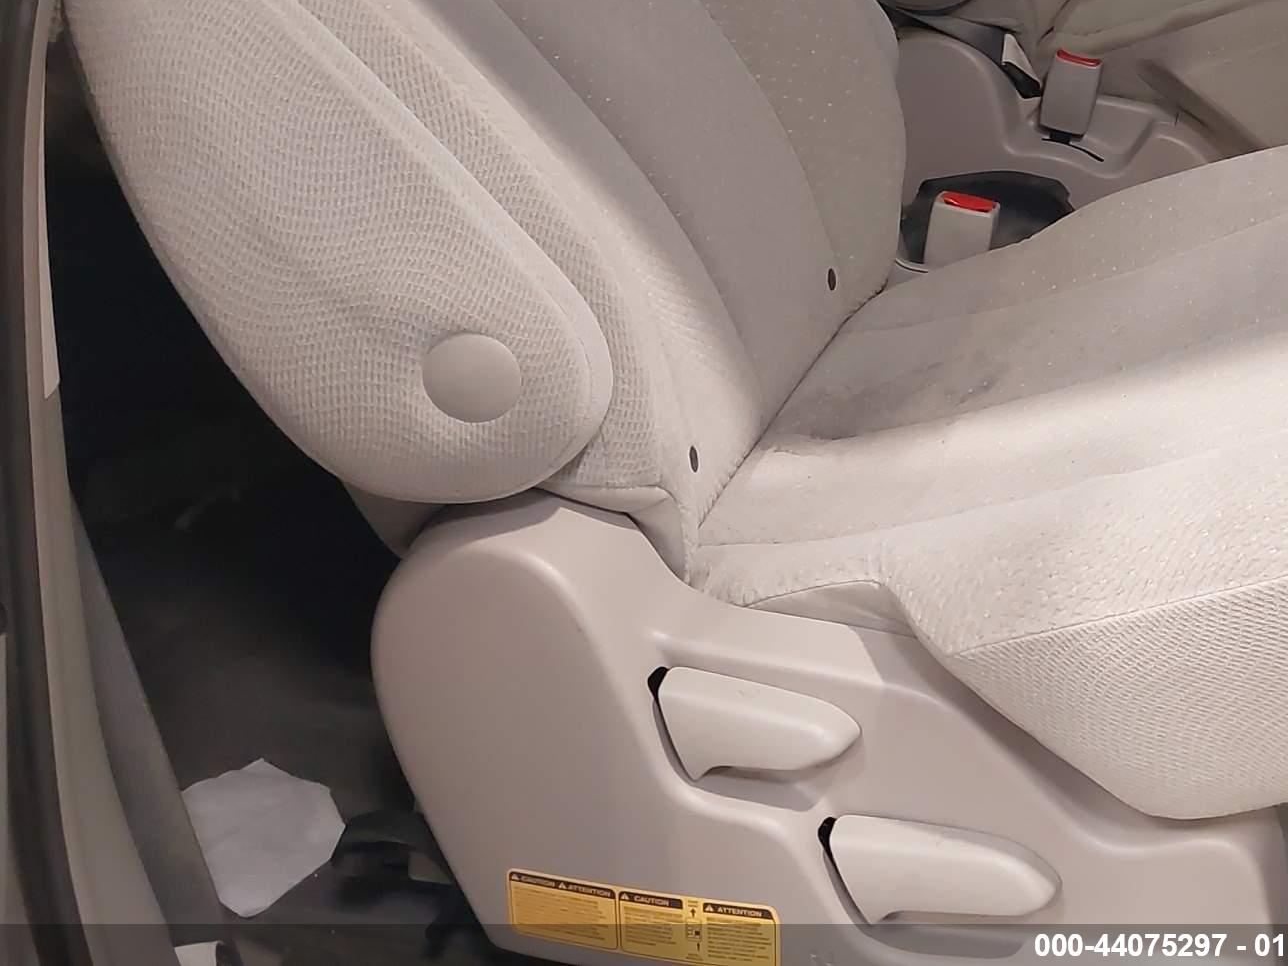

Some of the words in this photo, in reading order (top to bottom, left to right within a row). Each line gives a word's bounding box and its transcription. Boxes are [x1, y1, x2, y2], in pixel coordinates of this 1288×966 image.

[520, 875, 556, 889] CAUTION
[567, 884, 611, 898] ATTENTION
[633, 894, 670, 907] CAUTION
[716, 906, 763, 918] ATTENTION
